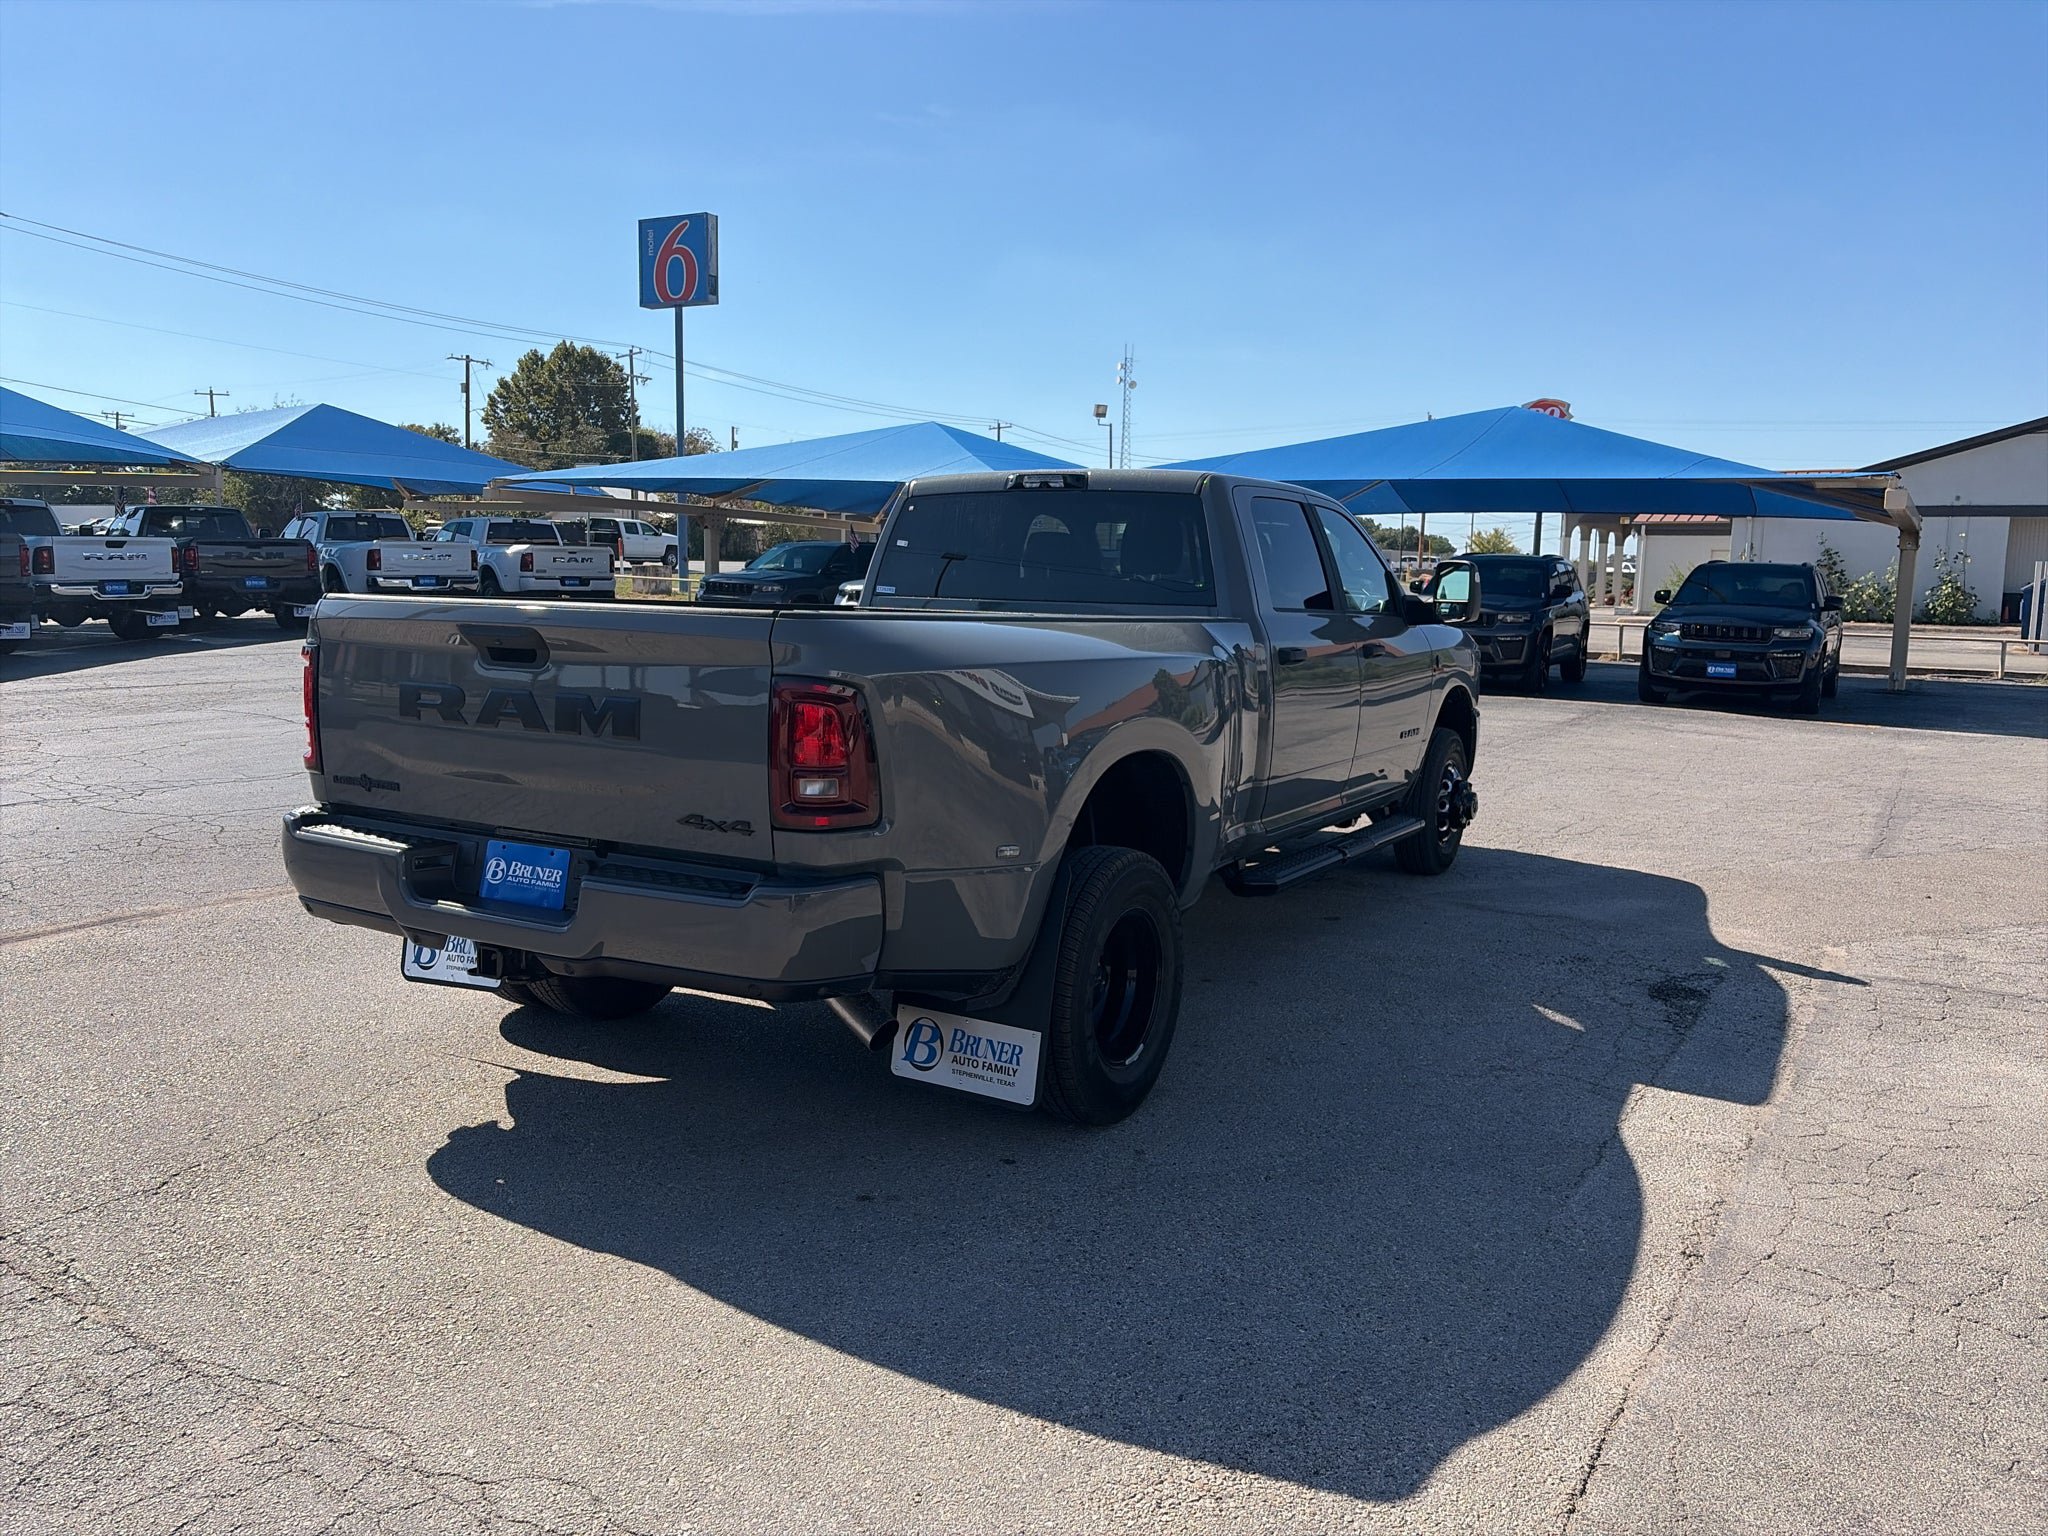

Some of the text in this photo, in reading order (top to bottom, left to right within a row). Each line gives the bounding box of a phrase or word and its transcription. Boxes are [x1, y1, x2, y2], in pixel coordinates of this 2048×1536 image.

[653, 219, 699, 303] 6
[552, 556, 594, 564] RAM
[399, 681, 641, 741] RAM
[506, 875, 530, 884] AUTO
[531, 879, 561, 889] FAMILY
[507, 861, 563, 883] BRUNER
[444, 935, 478, 955] BRUN
[446, 953, 466, 963] AUTO
[948, 1027, 1024, 1067] BRUNER
[951, 1054, 1018, 1078] AUTO FAMILY
[951, 1068, 1016, 1088] STEPHENVILLE, TEXAS
